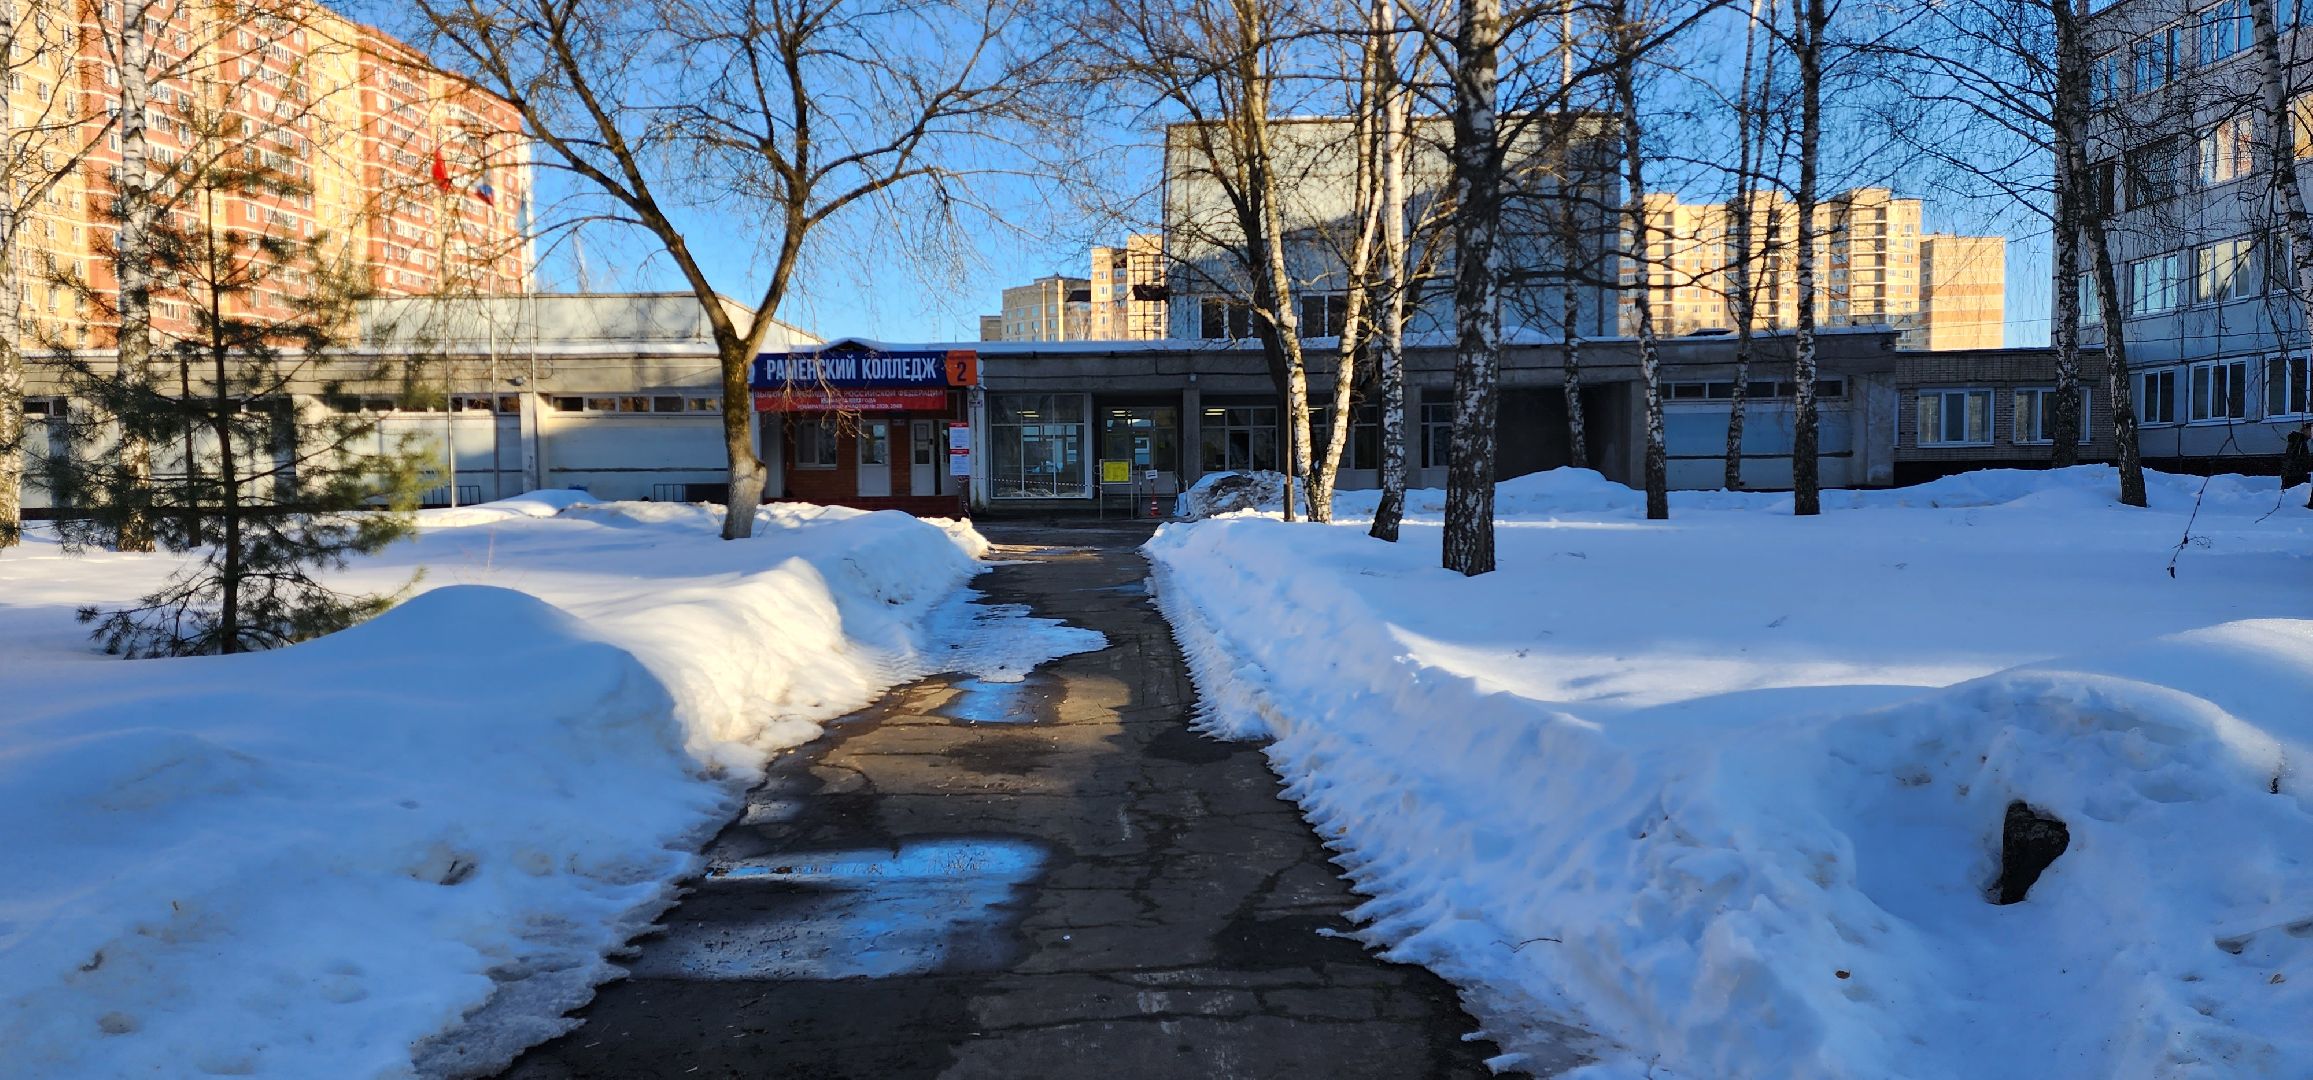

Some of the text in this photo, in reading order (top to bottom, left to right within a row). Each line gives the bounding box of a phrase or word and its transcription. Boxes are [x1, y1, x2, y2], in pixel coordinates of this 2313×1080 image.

[767, 355, 936, 381] РАМЕНСКИЙ КОЛЛЕДЖ
[957, 361, 967, 382] 2
